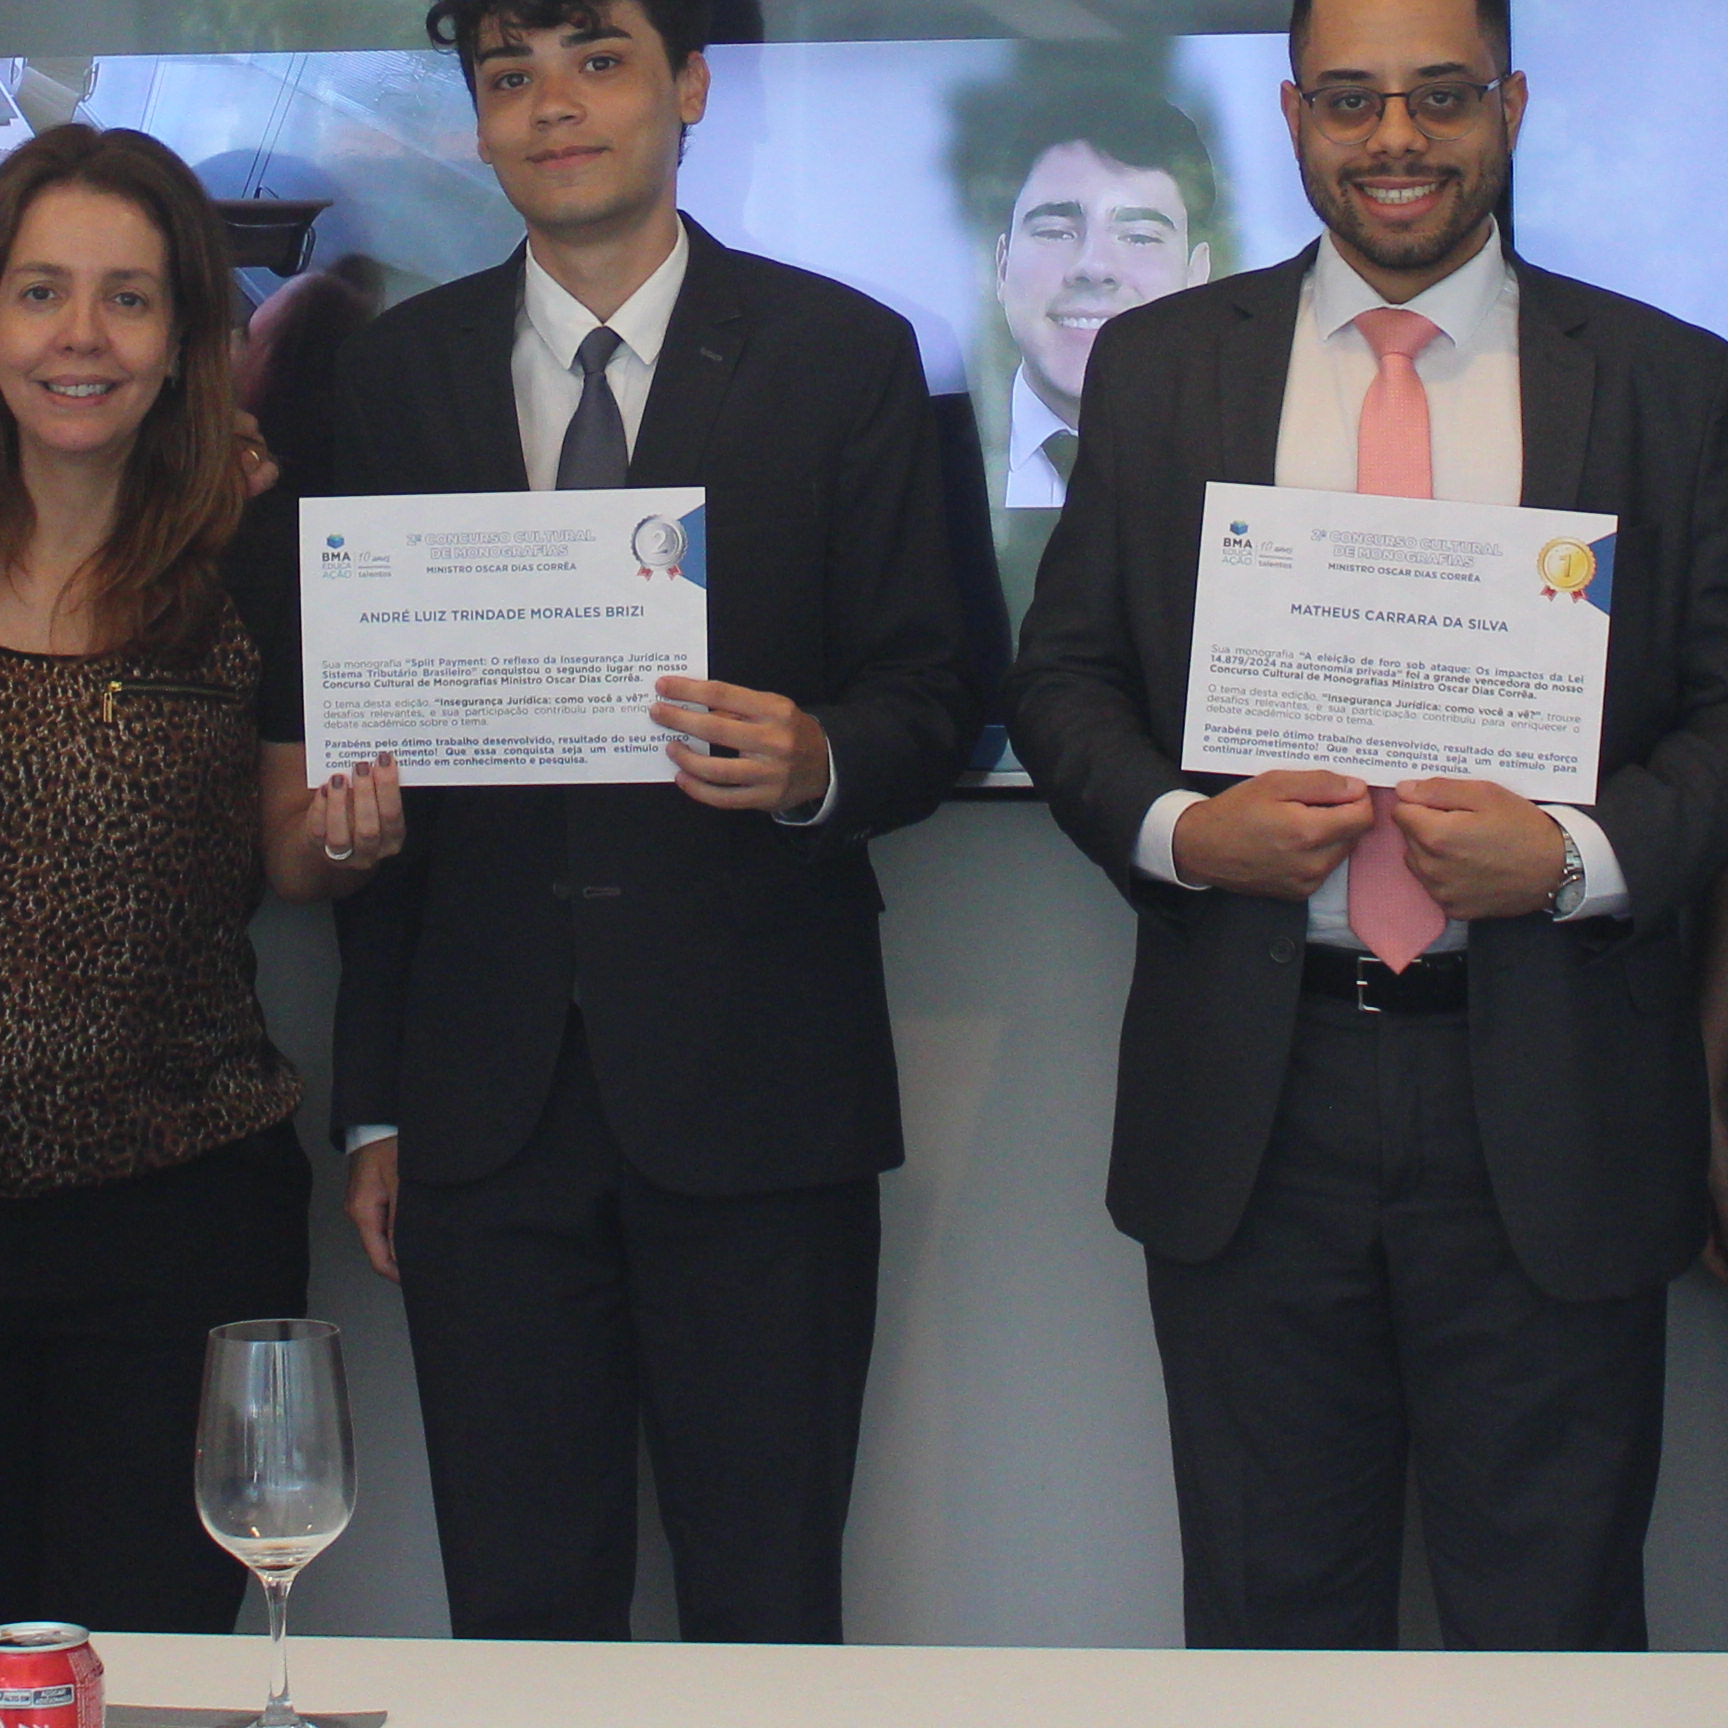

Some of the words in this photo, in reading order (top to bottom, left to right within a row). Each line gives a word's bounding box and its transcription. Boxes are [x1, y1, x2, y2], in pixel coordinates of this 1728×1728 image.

[424, 531, 511, 545] CONCURSO
[512, 529, 596, 543] CULTURAL
[651, 528, 669, 554] 2
[1223, 536, 1253, 549] BMA
[1328, 529, 1418, 549] CONCURSO
[1418, 536, 1504, 556] CULTURAL
[321, 551, 351, 562] BMA
[429, 546, 452, 559] DE
[453, 543, 568, 559] MONOGRAFIAS
[1332, 543, 1356, 558] DE
[1356, 545, 1474, 568] MONOGRAFIAS
[426, 564, 473, 573] MINISTRO
[474, 564, 508, 573] OSCAR
[510, 563, 534, 572] DIAS
[536, 560, 576, 571] CORRÊA
[1327, 562, 1375, 574] MINISTRO
[1376, 566, 1412, 577] OSCAR
[1413, 569, 1437, 579] DIAS
[1439, 571, 1481, 582] CORRÊA
[1557, 552, 1572, 578] 1
[359, 608, 410, 623] ANDRÉ
[414, 609, 446, 622] LUIZ
[451, 607, 525, 621] TRINDADE
[530, 606, 600, 619] MORALES
[605, 604, 644, 618] BRIZI
[1290, 603, 1360, 620] MATHEUS
[1364, 609, 1438, 626] CARRARA
[1442, 615, 1463, 628] DA
[1467, 618, 1509, 632] SILVA
[438, 657, 486, 668] Payment:
[503, 656, 539, 665] reflexo
[560, 655, 624, 665] Insegurança
[627, 653, 670, 662] Jurídica
[1316, 652, 1356, 664] eleição
[1360, 656, 1374, 666] de
[1378, 657, 1401, 668] foro
[1405, 660, 1426, 670] sob
[1430, 663, 1471, 674] ataque:
[1475, 665, 1490, 675] Os
[1494, 667, 1544, 680] impactos
[1548, 672, 1563, 682] da
[1567, 673, 1584, 683] Lei
[321, 670, 362, 679] Sistema
[368, 668, 418, 678] Tributário
[481, 666, 540, 677] conquistou
[556, 664, 602, 675] segundo
[606, 664, 633, 675] lugar
[1210, 653, 1277, 667] 14.879/2024
[1279, 661, 1293, 669] na
[1295, 662, 1353, 674] autonomia
[1405, 670, 1420, 680] foi
[1432, 673, 1471, 684] grande
[1474, 677, 1531, 689] vencedora
[1533, 681, 1548, 690] do
[1551, 684, 1583, 693] nosso
[322, 680, 371, 689] Concurso
[373, 678, 414, 688] Cultural
[433, 677, 497, 687] Monografias
[500, 676, 543, 685] Ministro
[545, 675, 575, 684] Oscar
[579, 674, 601, 683] Dias
[604, 673, 643, 683] Corrêa.
[1209, 663, 1259, 676] Concurso
[1261, 667, 1304, 680] Cultural
[1306, 671, 1320, 681] de
[1322, 673, 1389, 687] Monografias
[1391, 679, 1435, 691] Ministro
[1437, 682, 1468, 693] Oscar
[1471, 685, 1495, 696] Dias
[1497, 687, 1537, 699] Corrêa.
[506, 696, 551, 705] Jurídica:
[554, 696, 584, 704] como
[587, 694, 612, 703] você
[1395, 699, 1441, 711] Jurídica:
[1444, 705, 1475, 714] como
[1477, 707, 1503, 717] você
[324, 739, 371, 748] Parabéns
[374, 738, 398, 749] pelo
[400, 738, 432, 747] ótimo
[435, 737, 479, 746] trabalho
[558, 734, 607, 744] resultado
[628, 735, 646, 743] seu
[445, 747, 466, 756] Que
[473, 748, 496, 756] essa
[503, 745, 554, 756] conquista
[561, 744, 582, 755] seja
[613, 743, 658, 753] estímulo
[1204, 722, 1253, 735] Parabéns
[1255, 728, 1280, 738] pelo
[1282, 729, 1314, 740] ótimo
[1317, 732, 1362, 744] trabalho
[1443, 744, 1494, 756] resultado
[1497, 748, 1512, 757] do
[1515, 751, 1534, 759] seu
[1536, 752, 1578, 764] esforço
[452, 756, 526, 766] conhecimento
[538, 755, 587, 765] pesquisa.
[1202, 744, 1253, 755] continuar
[1255, 747, 1310, 760] investindo
[1312, 754, 1330, 762] em
[1332, 755, 1408, 769] conhecimento
[1420, 762, 1471, 774] pesquisa.
[1216, 735, 1319, 751] comprometimento!
[1325, 743, 1348, 754] Que
[1355, 747, 1379, 756] essa
[1385, 749, 1439, 761] conquista
[1445, 754, 1467, 765] seja
[1474, 757, 1492, 765] um
[1498, 759, 1546, 771] estímulo
[1552, 764, 1577, 773] para
